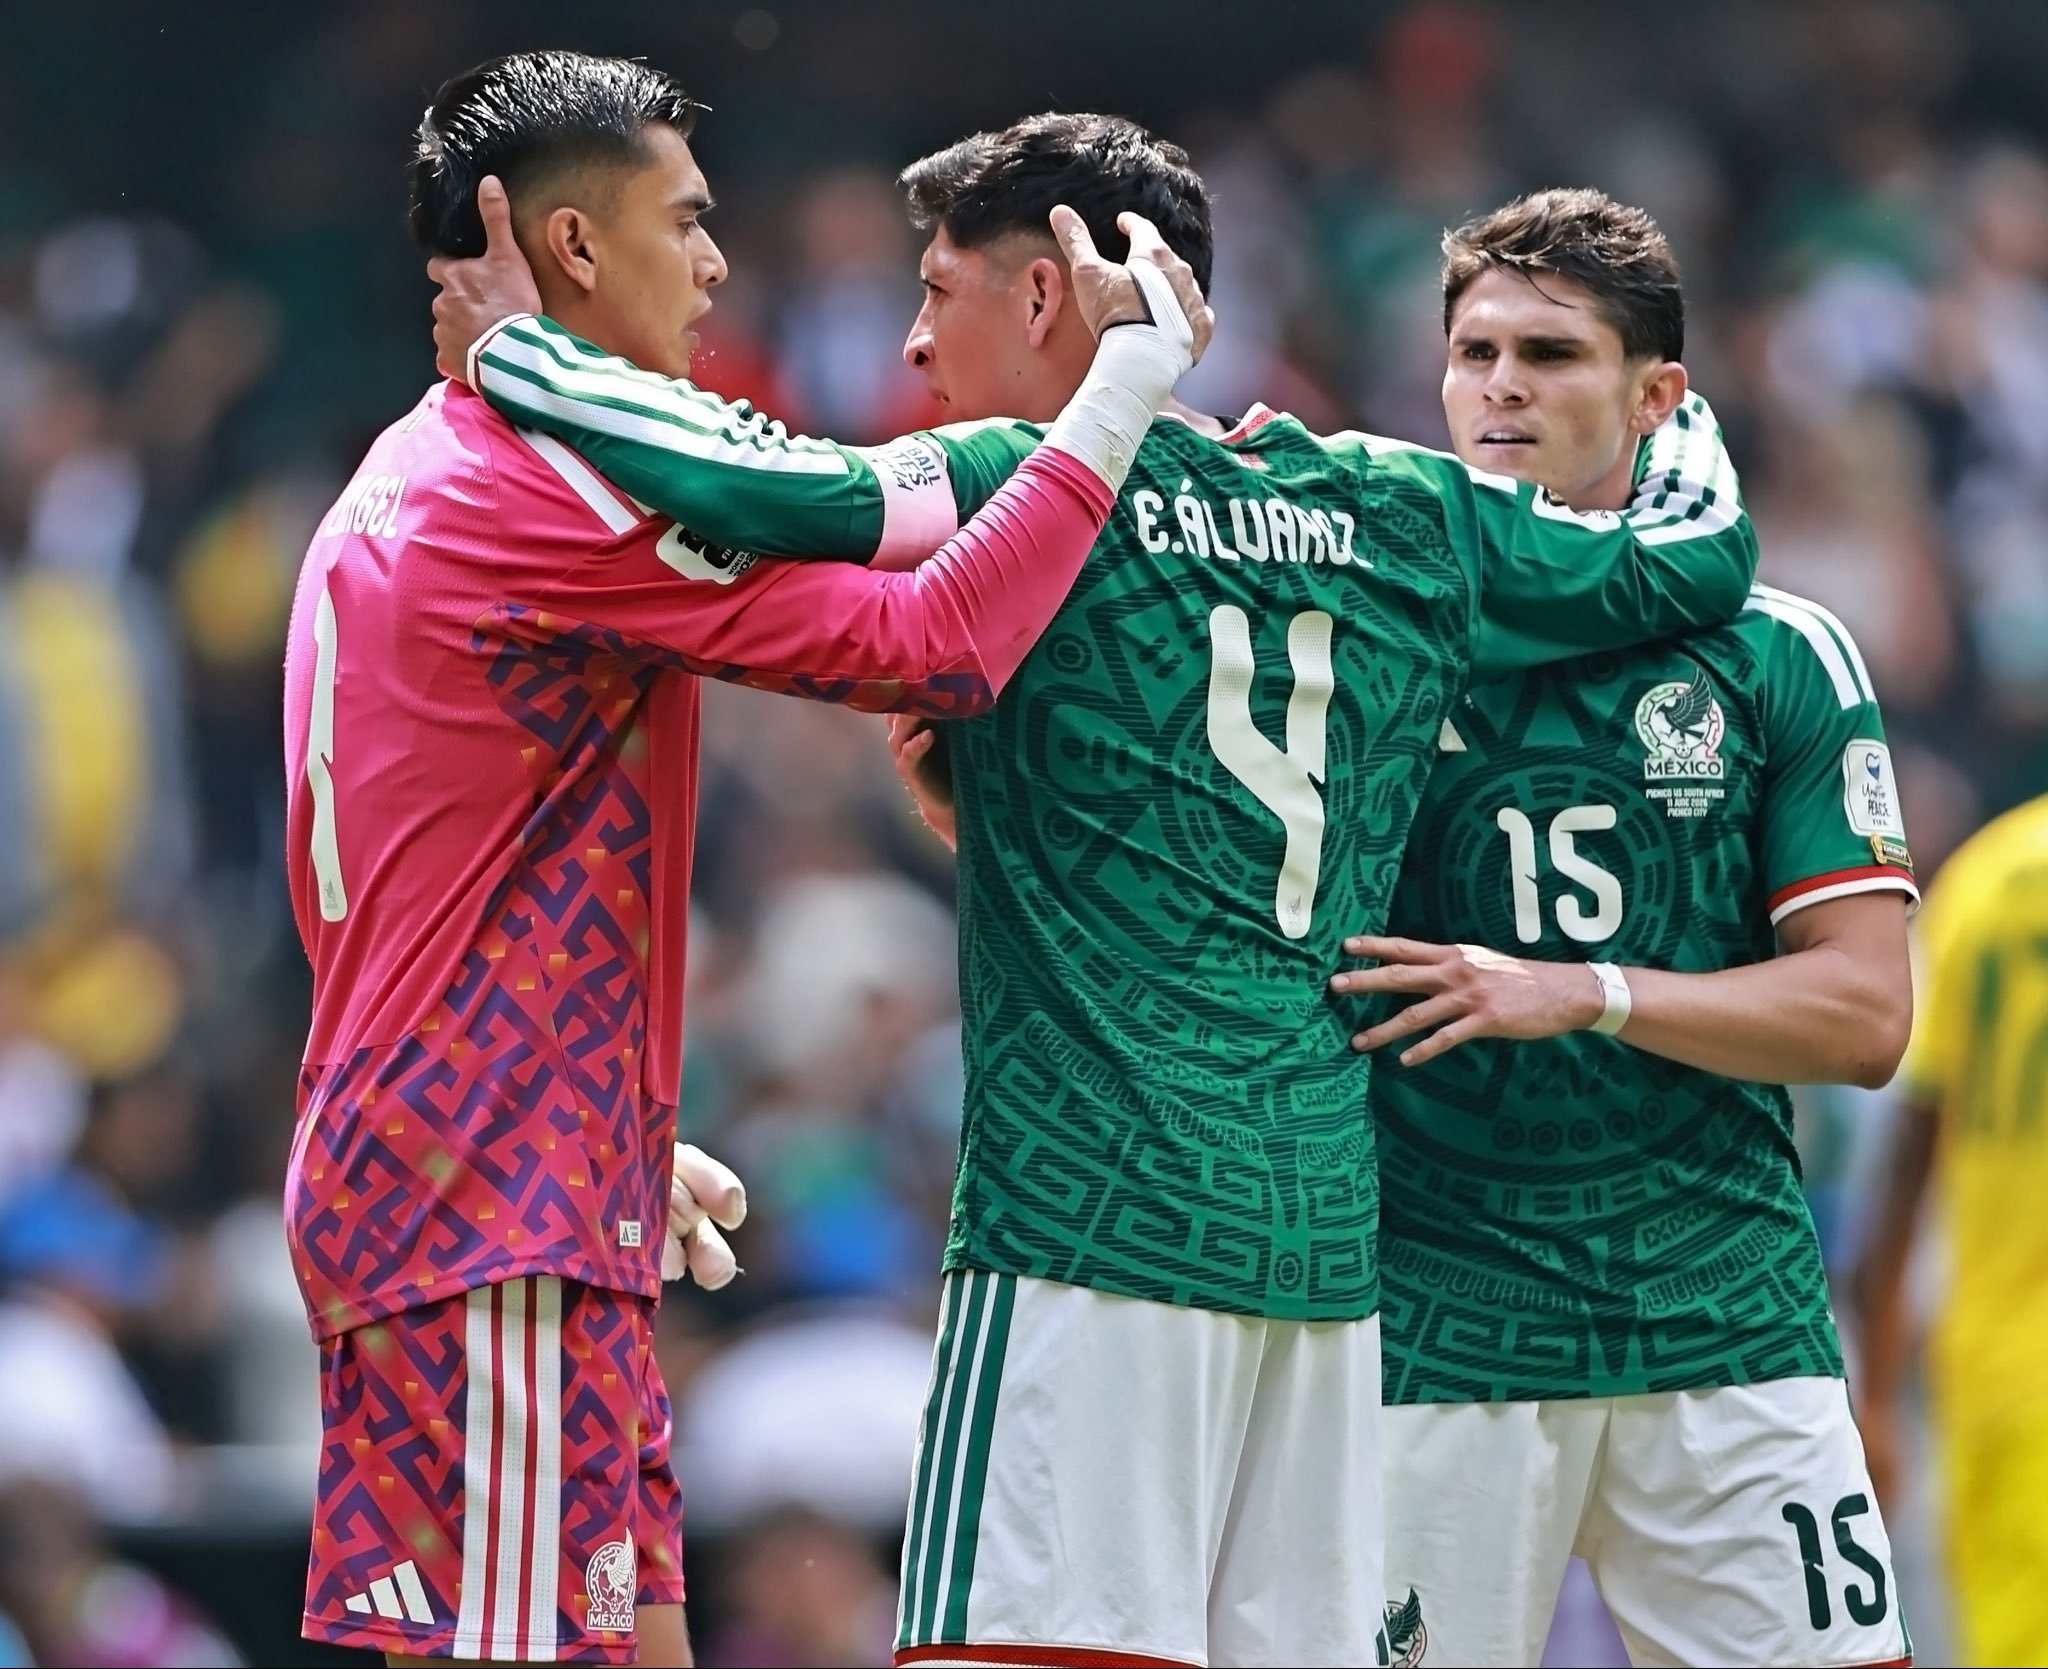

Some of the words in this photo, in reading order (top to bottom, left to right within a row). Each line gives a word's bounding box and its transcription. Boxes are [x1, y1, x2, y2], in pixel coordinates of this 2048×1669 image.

[727, 553, 746, 575] WORLD
[733, 552, 757, 577] 202
[307, 588, 348, 922] 1
[1647, 757, 1721, 776] MÉXICO
[1207, 604, 1335, 940] 4
[1683, 788, 1704, 798] SOUTH
[1693, 807, 1708, 817] CITY
[1497, 804, 1623, 944] 15
[1782, 1492, 1887, 1630] 15
[590, 1611, 633, 1628] MÉXICO
